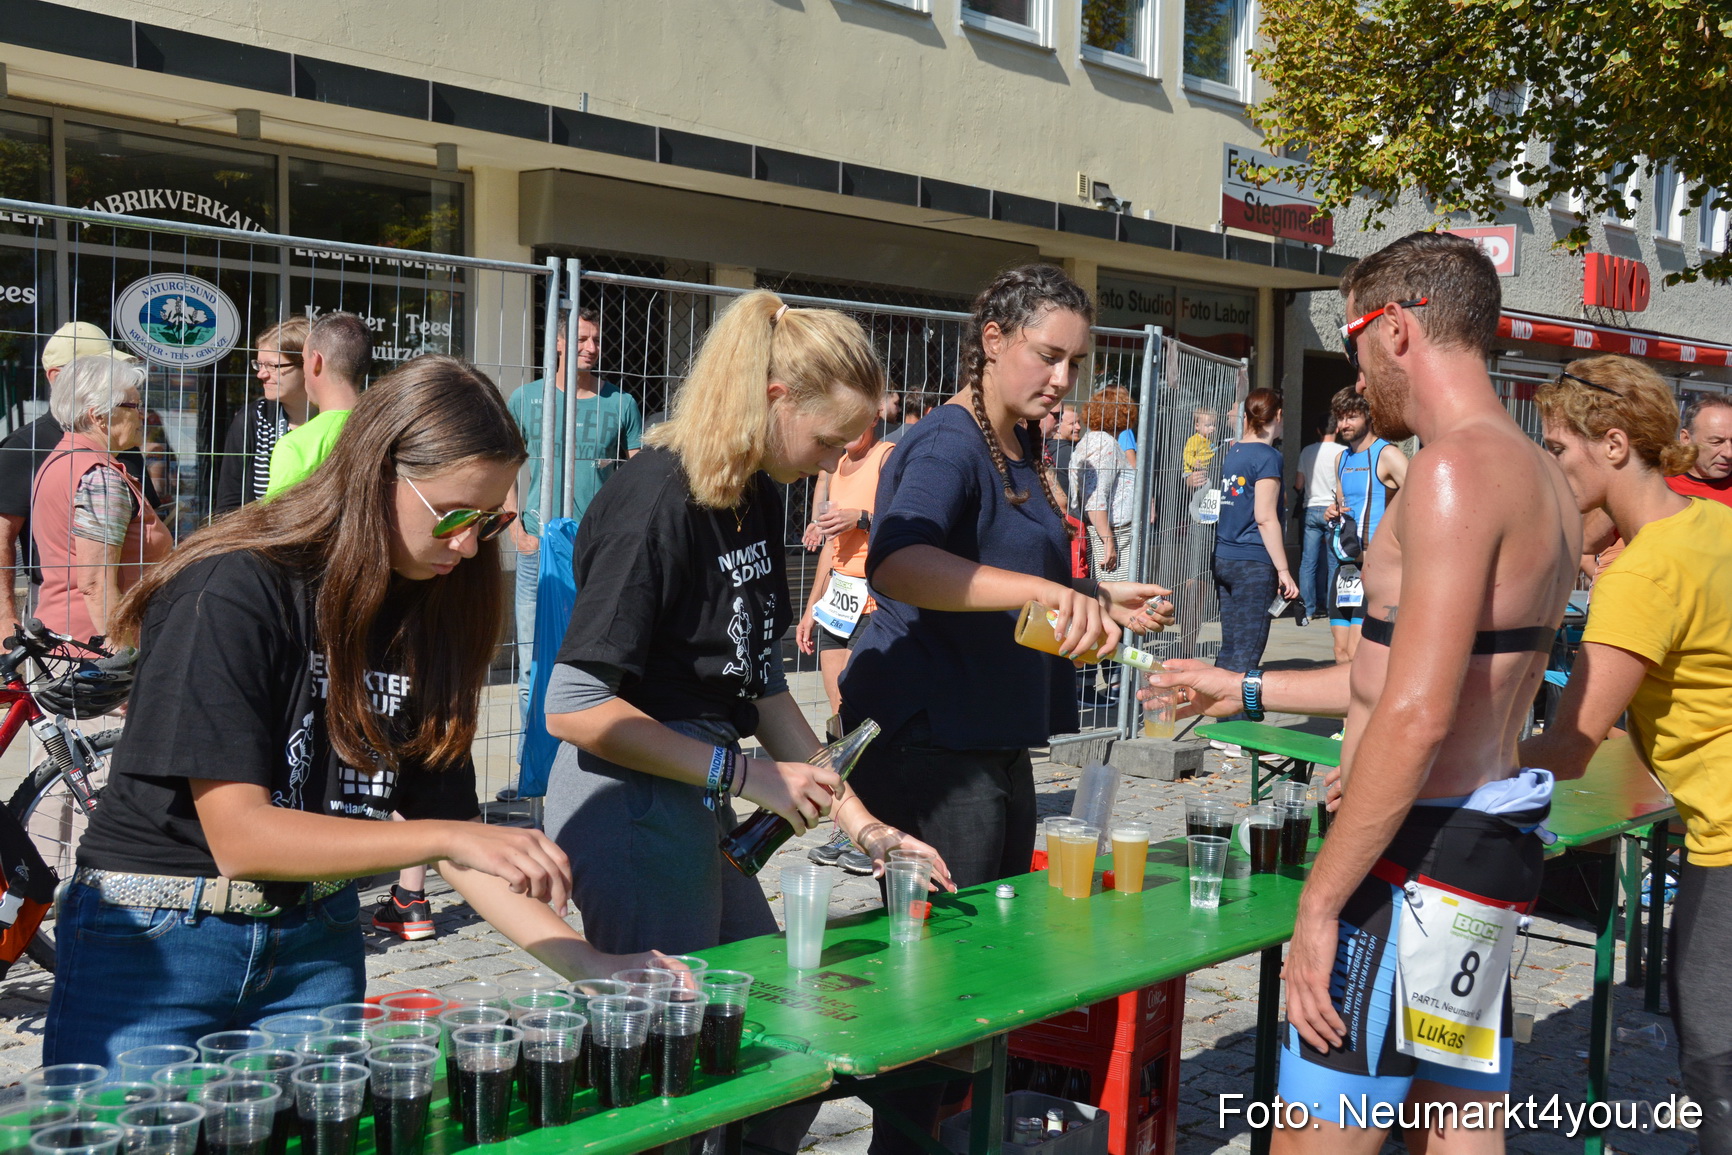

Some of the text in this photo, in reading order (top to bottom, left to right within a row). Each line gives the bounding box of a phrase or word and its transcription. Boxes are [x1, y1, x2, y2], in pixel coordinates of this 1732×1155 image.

[1244, 191, 1329, 237] Stegmeier
[141, 281, 217, 305] NATURGESUND
[1587, 252, 1650, 312] NKD
[1098, 288, 1250, 325] oto Studio Foto Labor
[405, 313, 451, 337] Tees
[1349, 317, 1365, 329] uvex
[1511, 319, 1533, 340] NKD
[195, 335, 228, 359] GEWRZE
[1573, 329, 1593, 349] NKD
[1629, 337, 1648, 357] NKD
[1679, 345, 1697, 363] NKD
[1450, 950, 1480, 998] 8
[1411, 991, 1440, 1009] PARTL
[1416, 1018, 1466, 1049] Lukas
